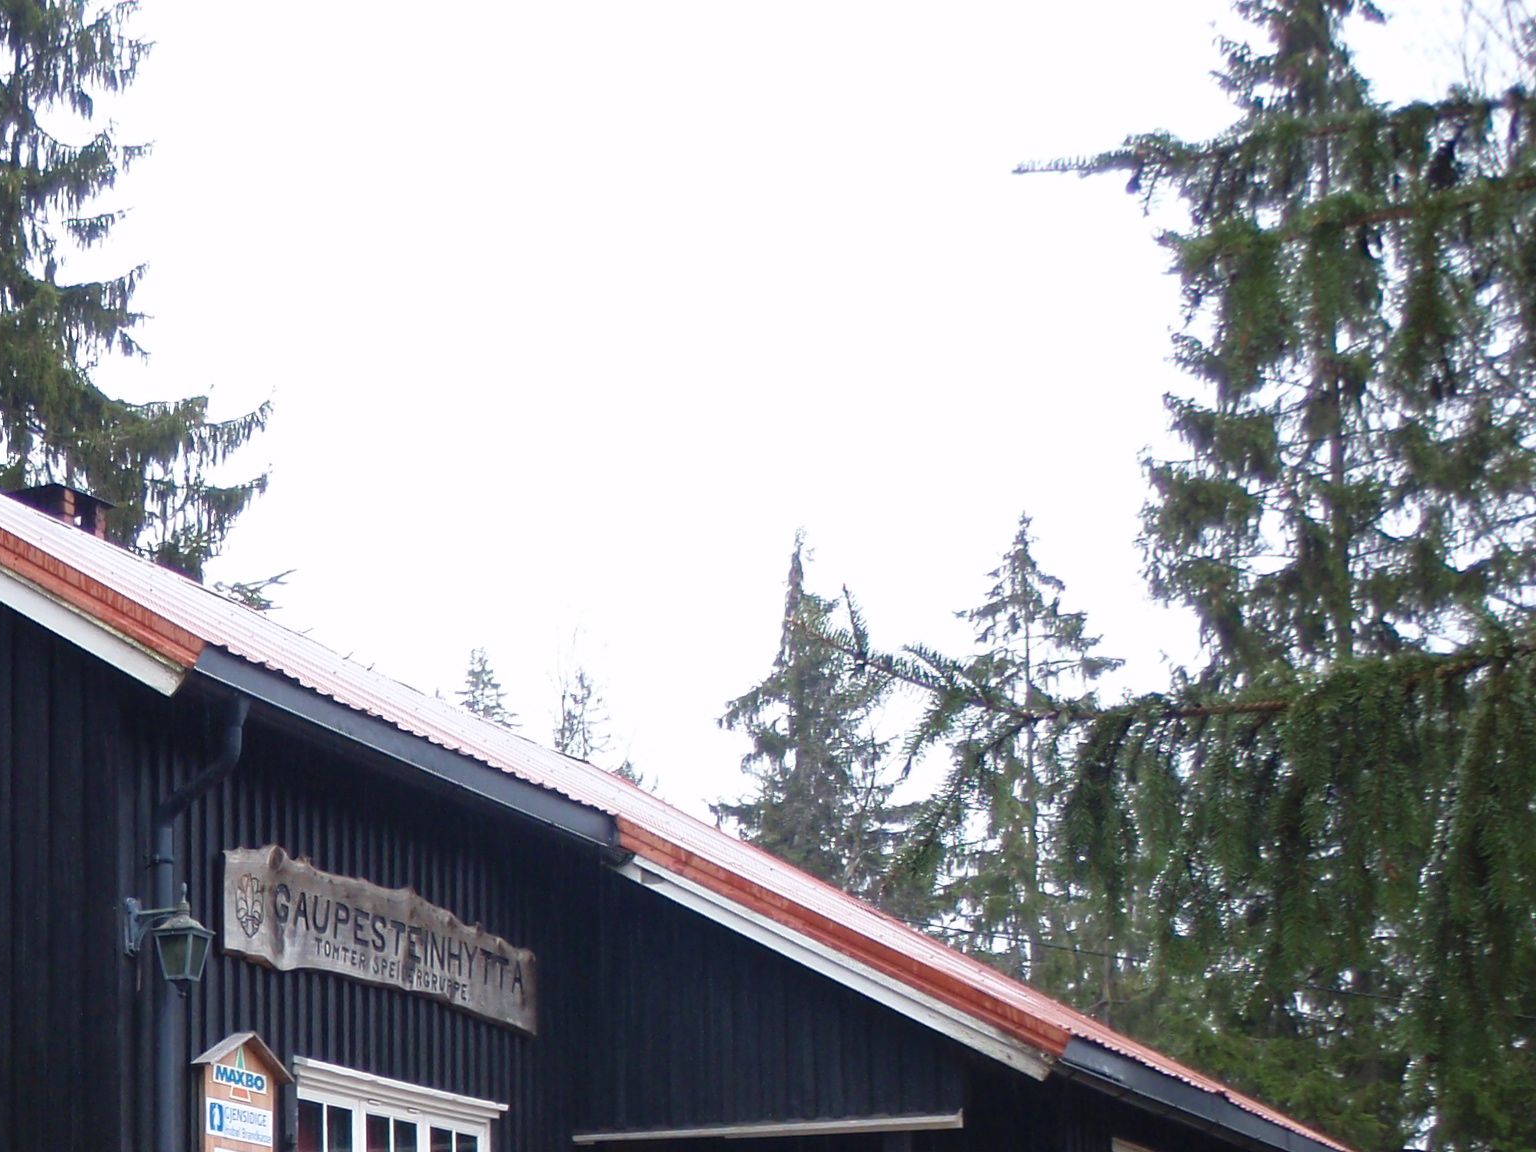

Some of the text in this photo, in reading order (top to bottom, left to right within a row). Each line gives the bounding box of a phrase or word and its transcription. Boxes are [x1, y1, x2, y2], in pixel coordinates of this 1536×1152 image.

[274, 883, 524, 995] GAUPESTEINHYTTA
[314, 937, 366, 972] TOMTER
[215, 1064, 265, 1091] MAXBO
